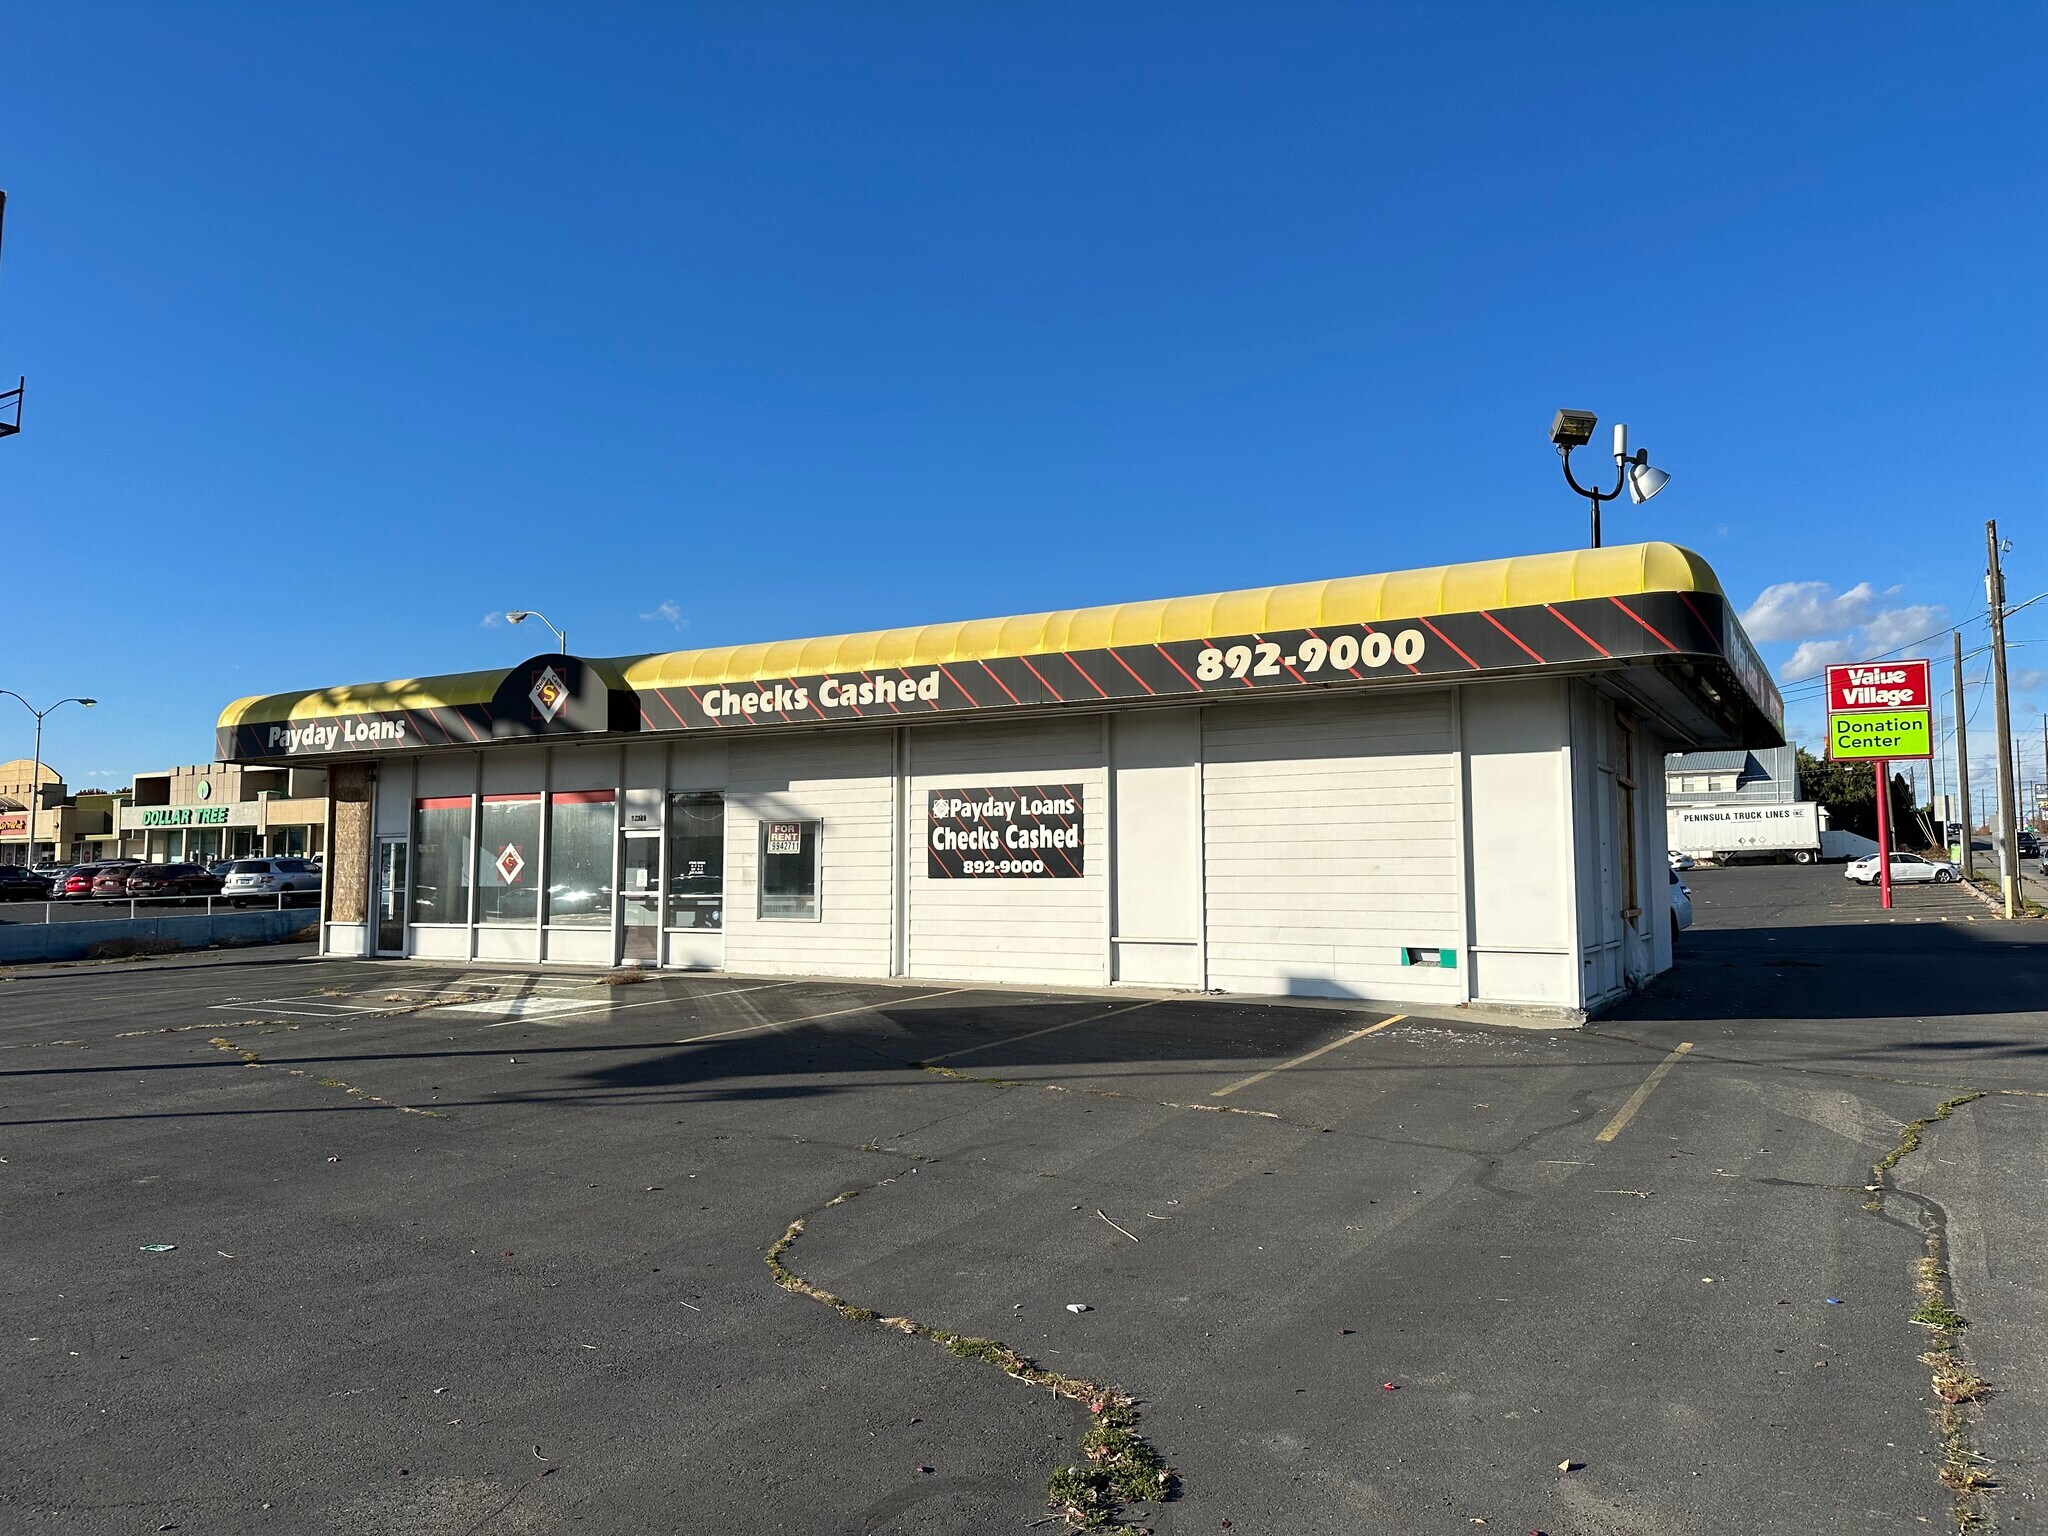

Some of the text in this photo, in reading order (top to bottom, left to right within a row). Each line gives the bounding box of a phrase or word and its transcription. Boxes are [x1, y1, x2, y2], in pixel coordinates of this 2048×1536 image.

[1196, 629, 1426, 682] 892-9000
[1847, 667, 1907, 686] Value
[702, 670, 940, 717] Checks Cashed
[1842, 686, 1914, 707] Village
[1837, 718, 1923, 734] Donation
[268, 719, 406, 753] Payday Loans
[1838, 735, 1901, 749] Center
[142, 807, 229, 827] DOLLAR TREE
[950, 795, 1075, 823] Payday Loans
[1683, 812, 1731, 823] PENINSULA
[1734, 811, 1762, 821] TRUCK
[1765, 810, 1790, 819] LINES
[771, 833, 798, 841] RENT
[774, 824, 795, 833] FOR
[932, 823, 1079, 850] Checks Cashed
[963, 859, 1044, 874] 892-9000
